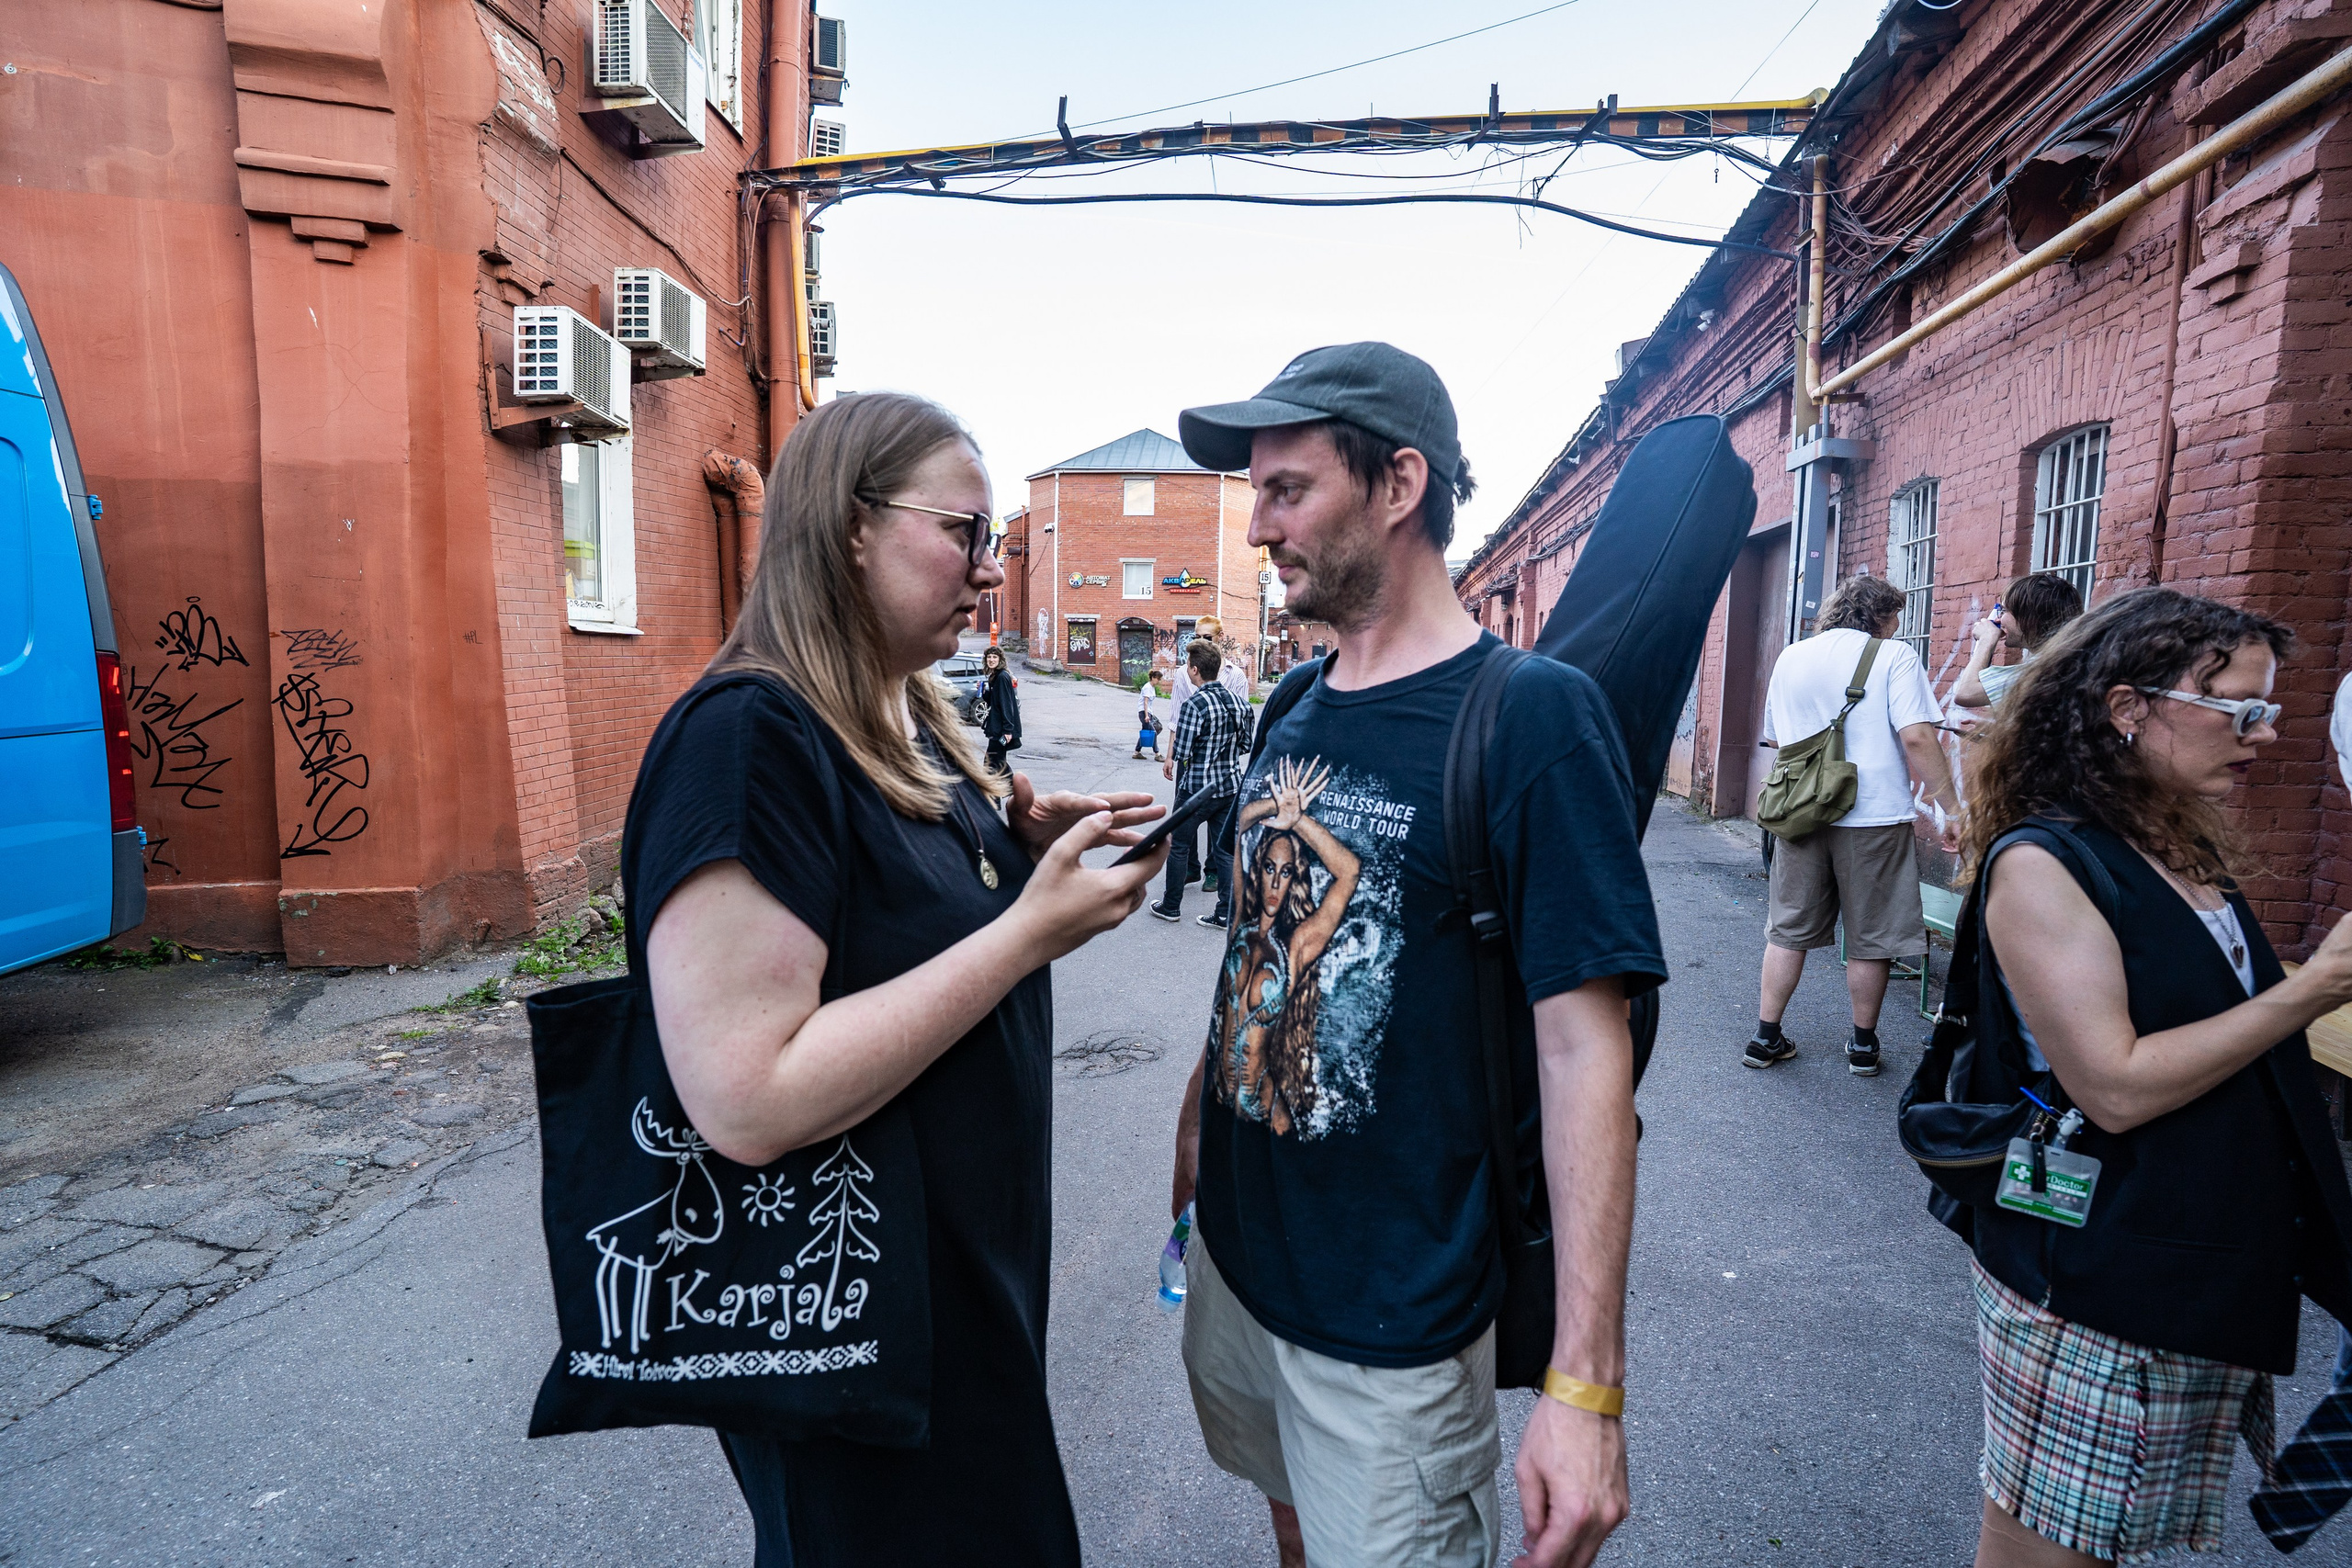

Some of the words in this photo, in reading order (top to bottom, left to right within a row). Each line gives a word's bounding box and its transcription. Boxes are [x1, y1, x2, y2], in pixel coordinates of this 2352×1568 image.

[1141, 587, 1151, 595] 15
[1162, 577, 1207, 585] АКВАРЕЛЬ
[1318, 790, 1417, 822] RENAISSANCE
[1323, 809, 1362, 830] WORLD
[1368, 818, 1409, 840] TOUR
[663, 1264, 869, 1341] Karjala
